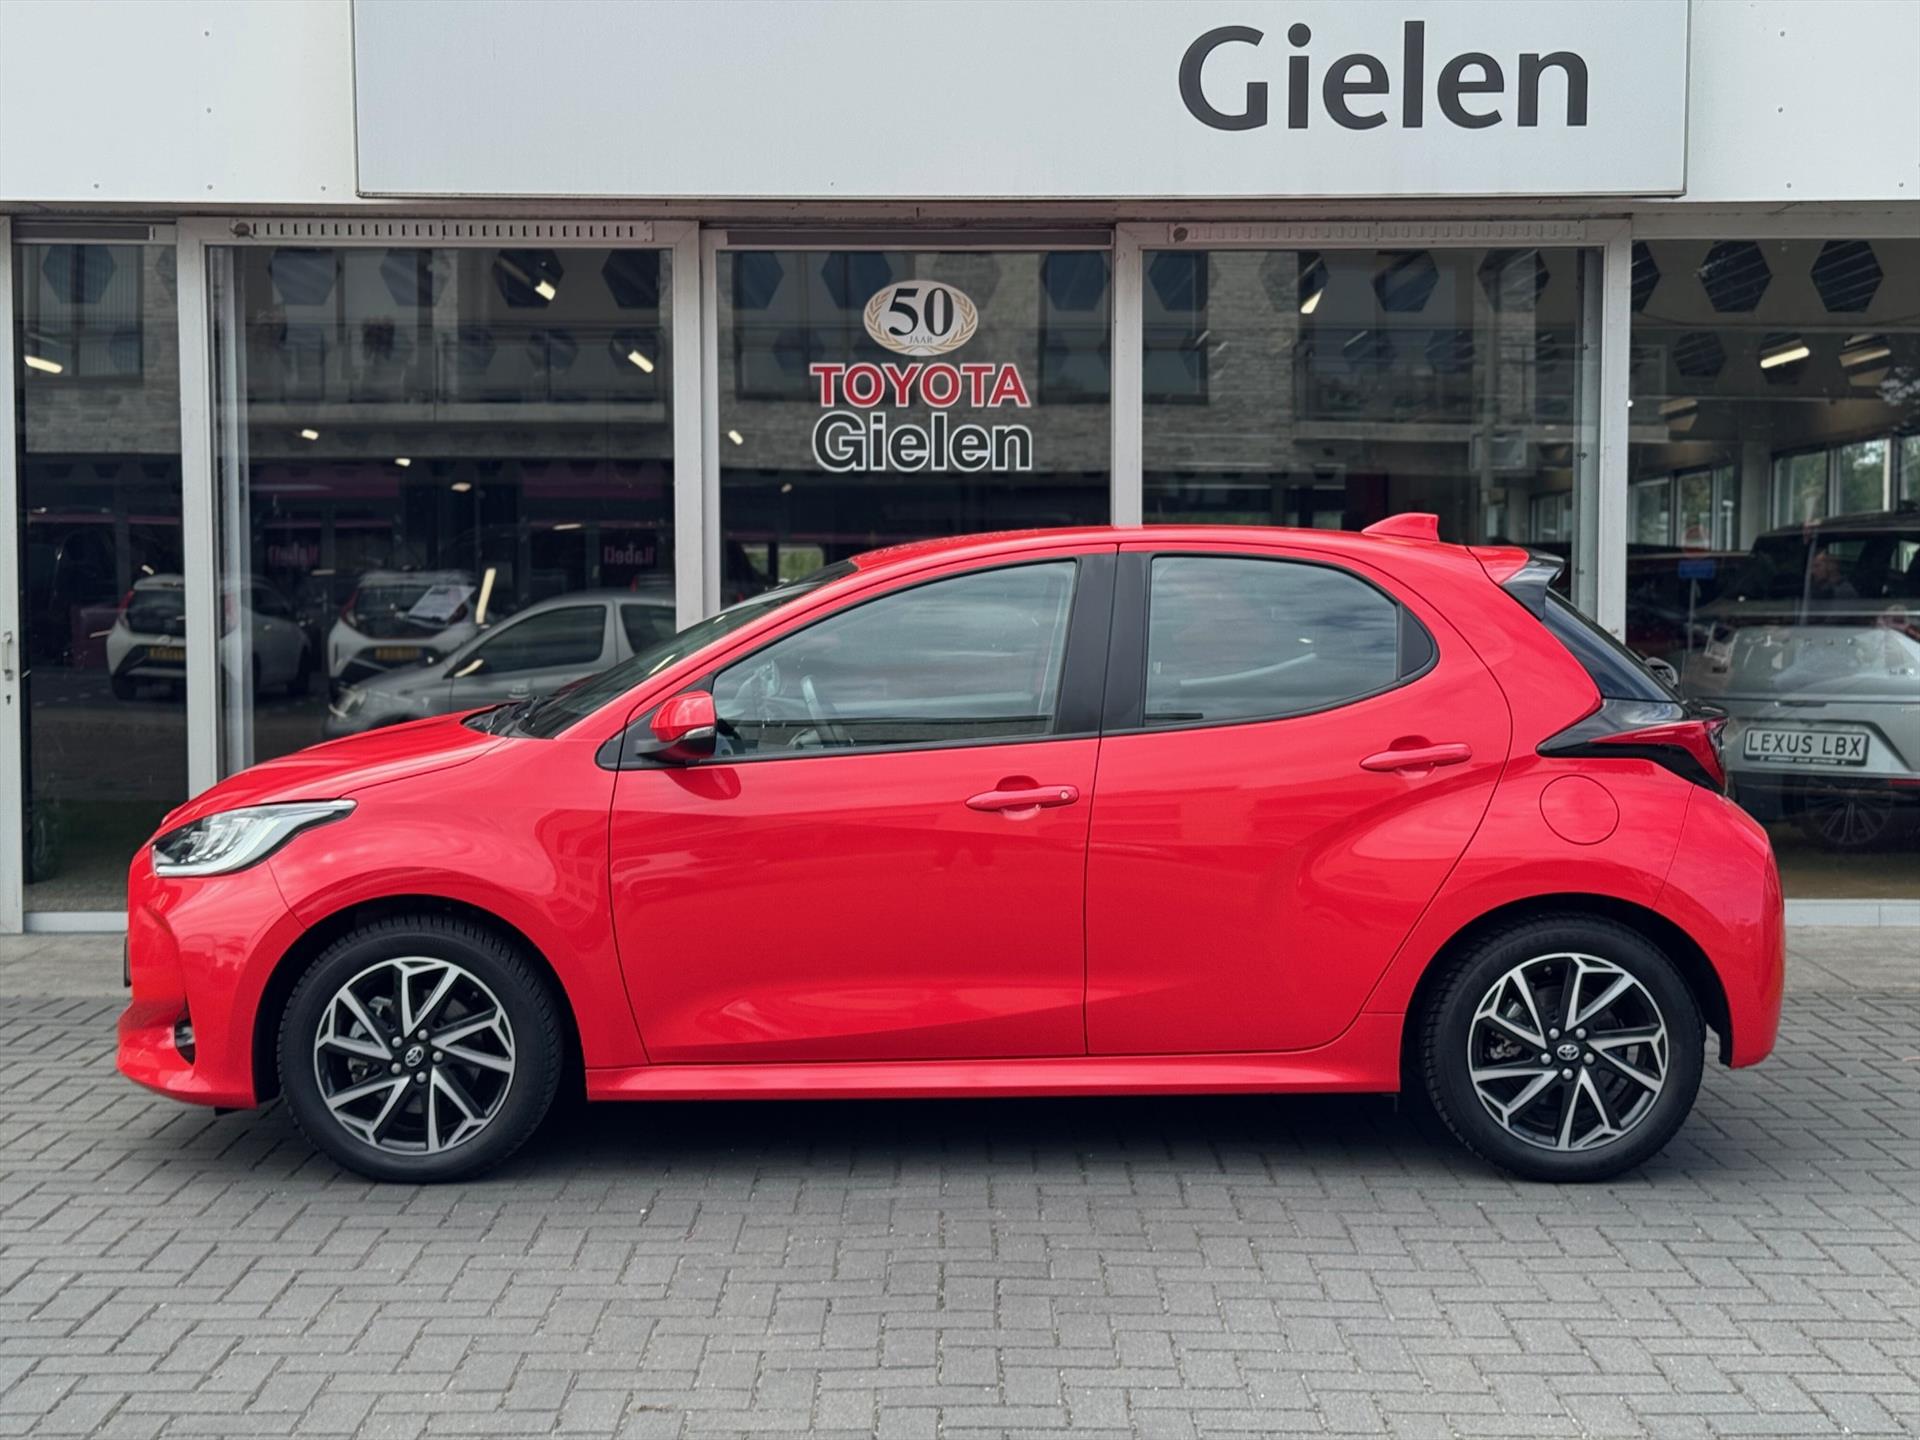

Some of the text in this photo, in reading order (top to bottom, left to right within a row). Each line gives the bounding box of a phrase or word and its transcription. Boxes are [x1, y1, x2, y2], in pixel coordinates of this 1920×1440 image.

[1178, 20, 1588, 131] Gielen
[888, 287, 954, 336] 50
[908, 335, 933, 344] JAAR
[809, 363, 1031, 408] TOYOTA
[812, 410, 1033, 472] Gielen
[1748, 733, 1861, 757] LEXUS LBX
